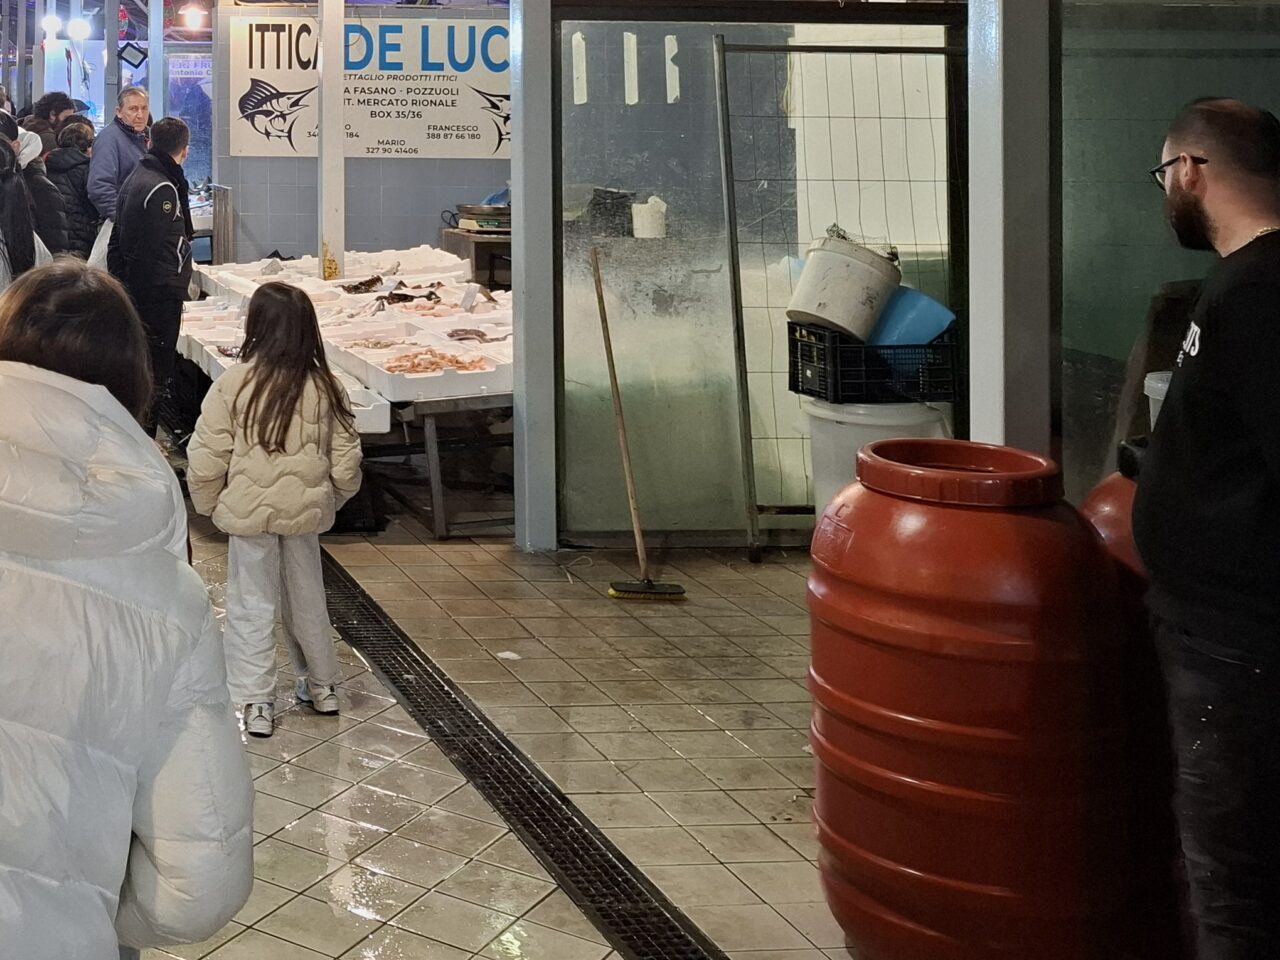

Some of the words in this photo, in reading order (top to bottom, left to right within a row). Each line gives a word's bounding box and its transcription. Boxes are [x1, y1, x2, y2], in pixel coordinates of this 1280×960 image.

[343, 24, 403, 71] DE
[421, 25, 510, 73] LUC
[343, 73, 384, 81] ETTAGLIO
[386, 74, 431, 82] PRODOTTI
[432, 74, 458, 82] ITTICI
[343, 86, 351, 95] A
[353, 86, 397, 95] FASANO
[406, 87, 460, 96] POZZUOLI
[357, 98, 408, 107] MERCATO
[411, 99, 458, 108] RIONALE
[370, 110, 392, 119] BOX
[394, 109, 423, 120] 35/36
[427, 124, 479, 132] FRANCESCO
[425, 132, 441, 140] 388
[443, 132, 454, 140] 87
[455, 132, 466, 140] 66
